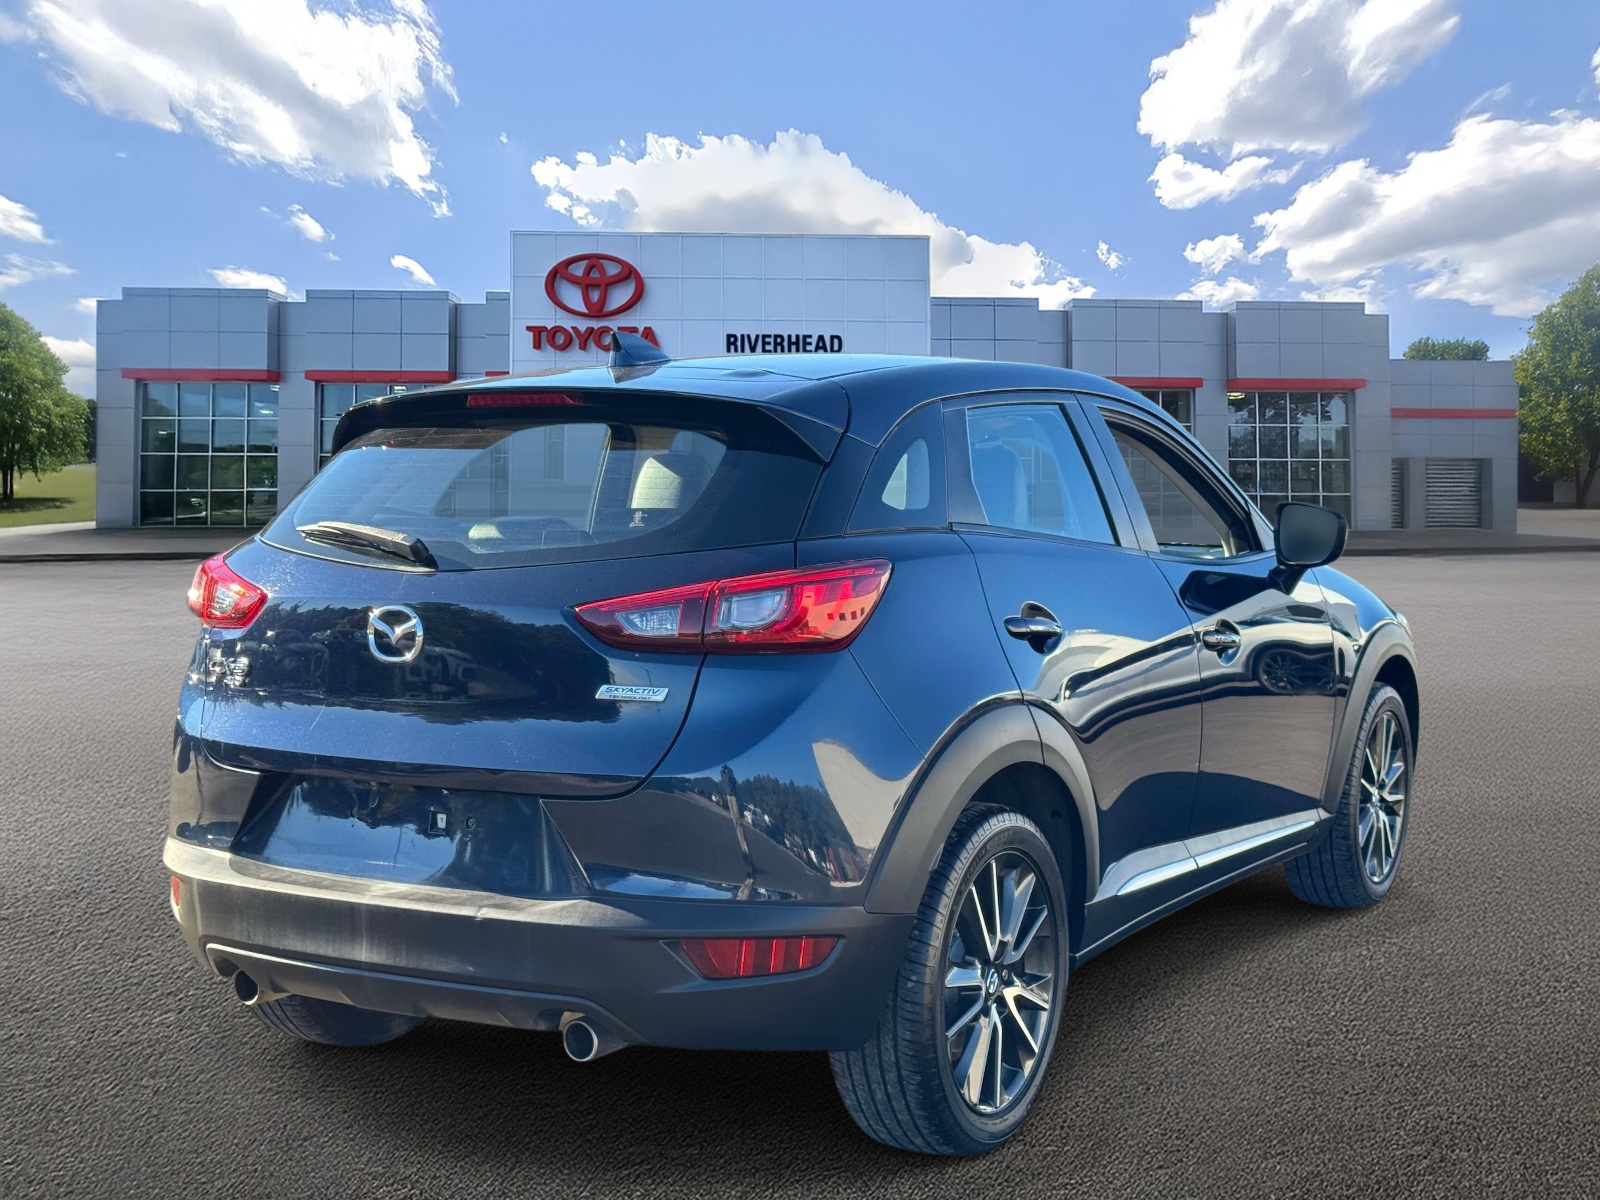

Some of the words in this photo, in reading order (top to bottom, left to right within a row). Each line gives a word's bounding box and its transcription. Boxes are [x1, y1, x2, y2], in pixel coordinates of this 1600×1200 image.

[525, 325, 661, 351] TOYOA
[726, 333, 843, 353] RIVERHEAD
[604, 686, 661, 695] SKYACTIV
